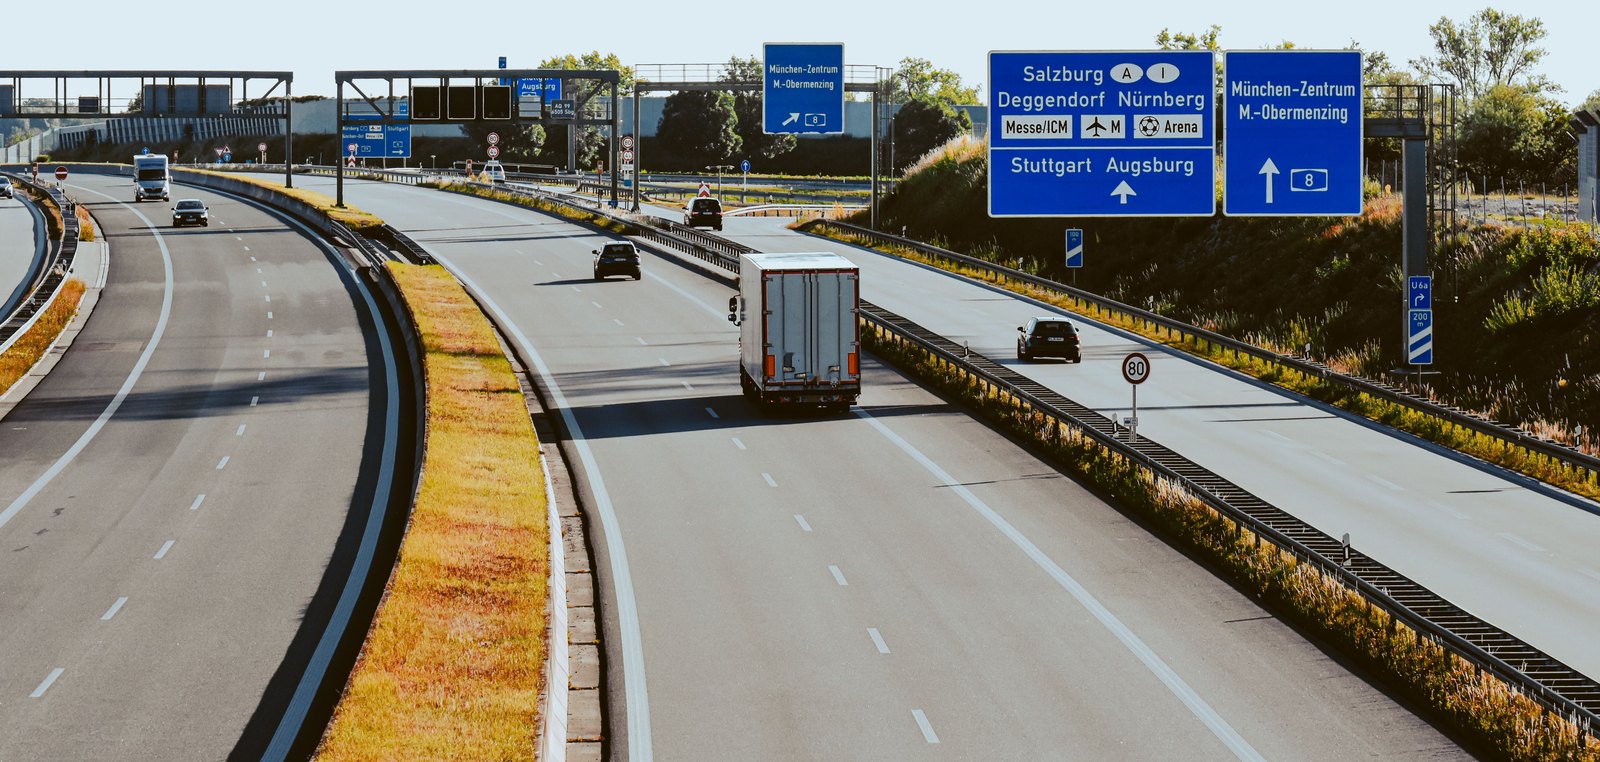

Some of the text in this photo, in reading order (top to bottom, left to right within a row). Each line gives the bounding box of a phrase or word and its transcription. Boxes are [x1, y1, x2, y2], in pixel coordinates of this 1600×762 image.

[769, 64, 838, 74] München-Zentrum
[1023, 66, 1104, 86] Salzburg
[1122, 68, 1132, 79] A
[773, 79, 834, 90] M.-Obermenzing
[1231, 80, 1356, 97] München-Zentrum
[998, 91, 1205, 112] Deggendorf Nürnberg
[812, 116, 818, 124] 8
[1239, 104, 1348, 124] M.-Obermenzing
[1006, 120, 1198, 134] Messe/ICM M Arena
[1011, 156, 1194, 177] Stuttgart Augsburg
[1304, 173, 1314, 187] 8
[1413, 313, 1428, 321] 200
[1128, 361, 1145, 376] 80
